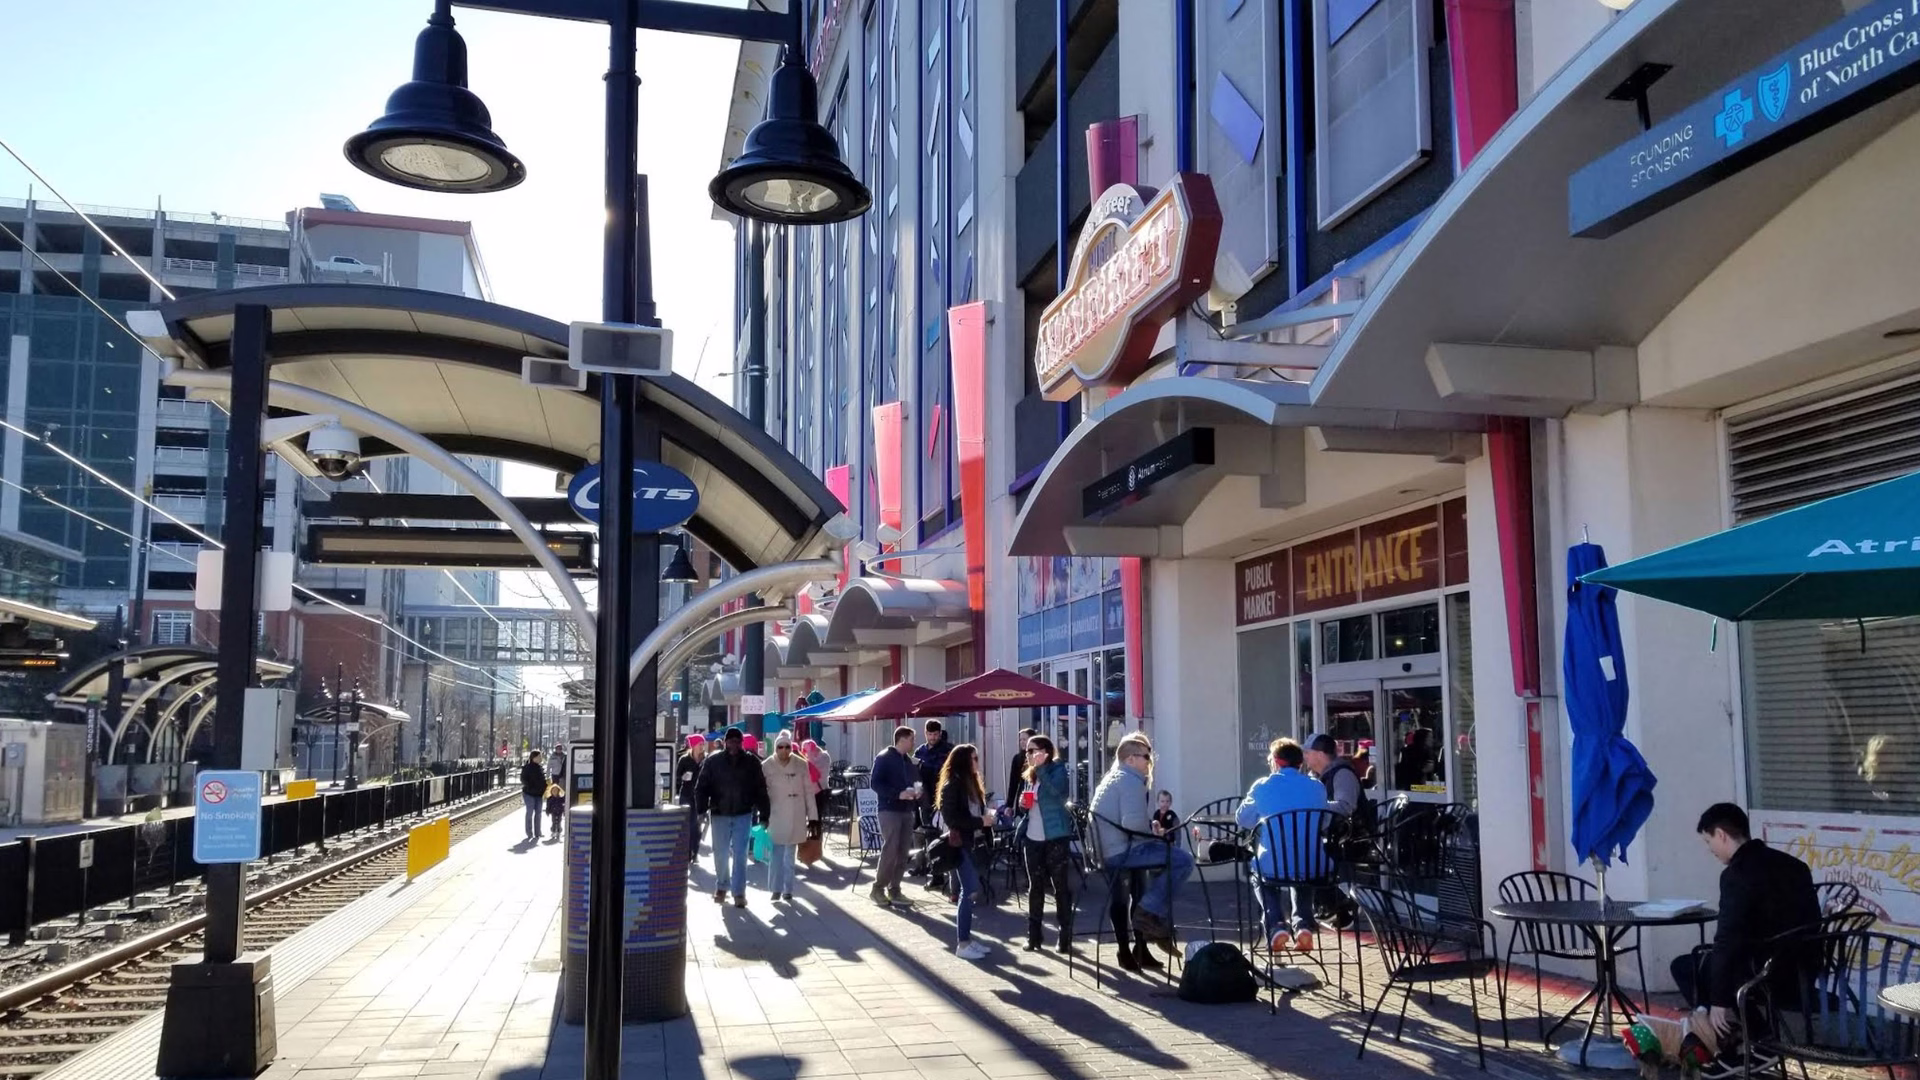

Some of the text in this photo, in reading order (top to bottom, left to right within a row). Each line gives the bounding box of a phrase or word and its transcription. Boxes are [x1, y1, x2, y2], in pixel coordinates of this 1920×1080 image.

[1800, 8, 1904, 77] BlueCross
[1800, 77, 1821, 104] of
[1825, 47, 1884, 93] North
[1630, 124, 1693, 166] FOUNDING
[1039, 204, 1173, 376] MARKET
[575, 467, 694, 510] CTS
[1245, 562, 1273, 591] PUBLIC
[1305, 530, 1424, 601] ENTRANCE
[1243, 590, 1276, 620] MARKET
[200, 811, 256, 821] No Smoking
